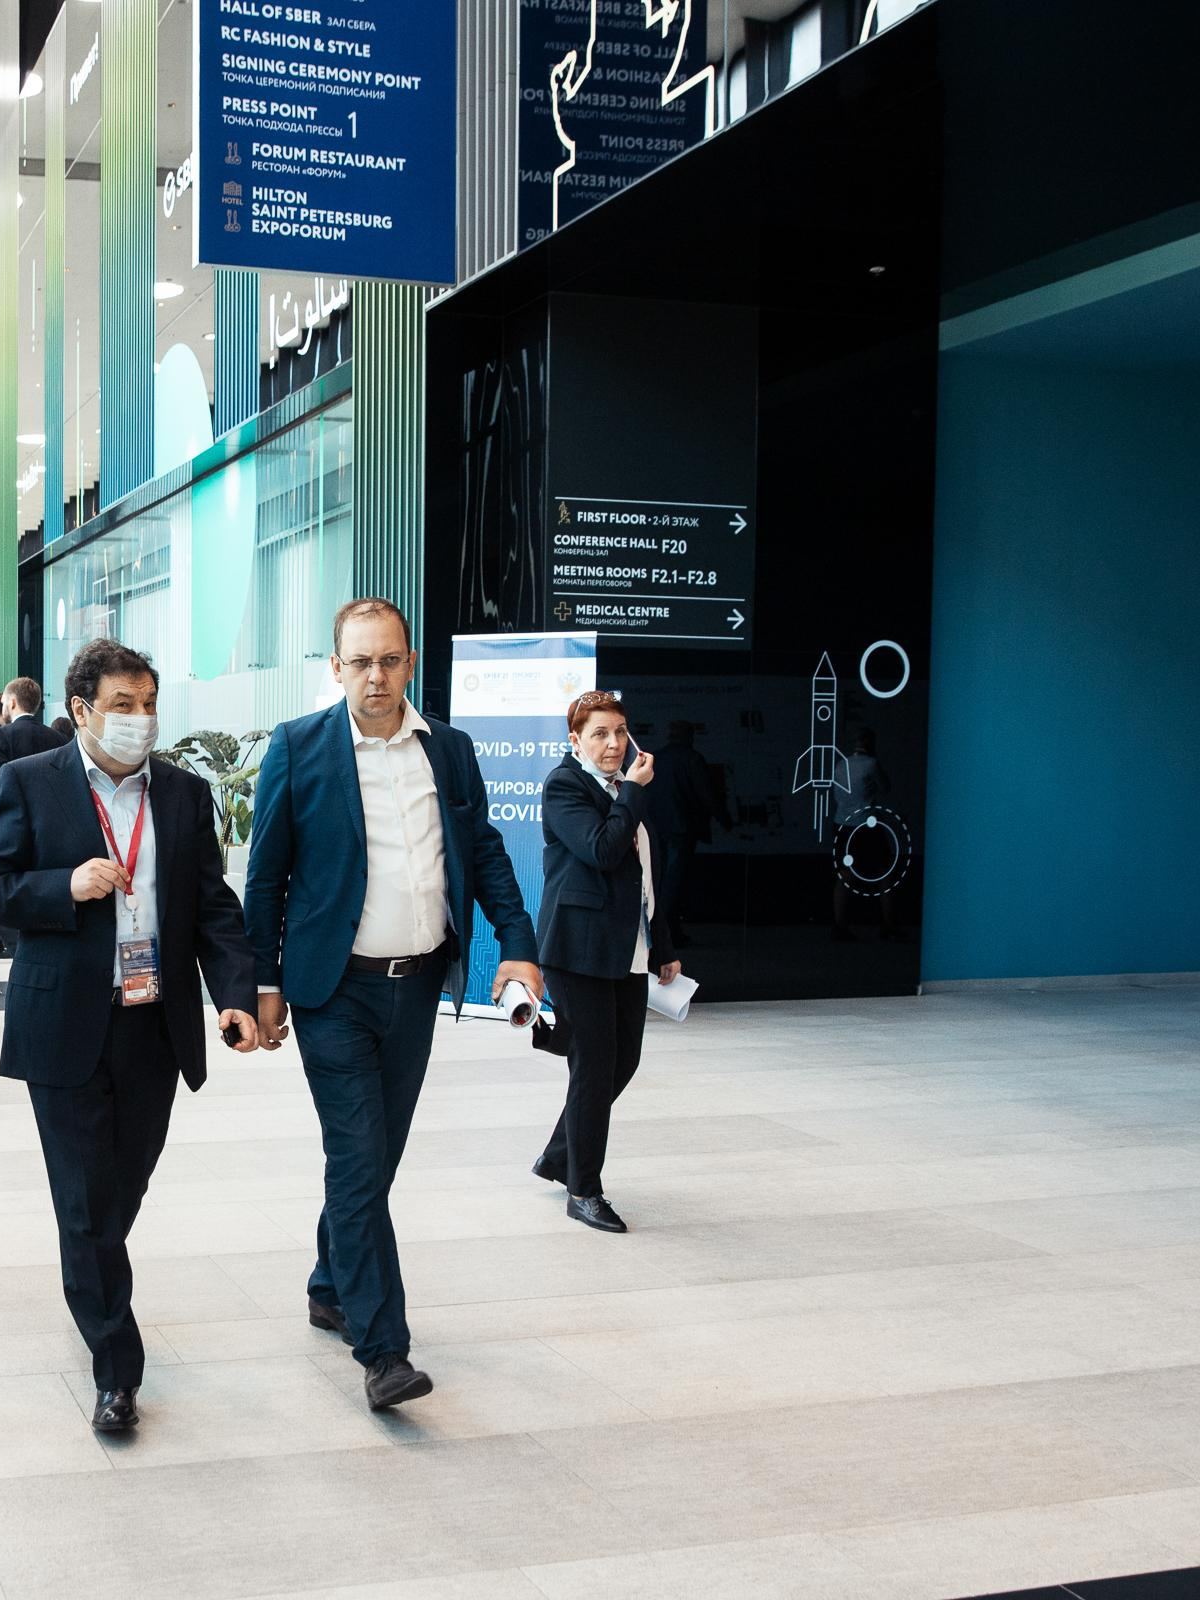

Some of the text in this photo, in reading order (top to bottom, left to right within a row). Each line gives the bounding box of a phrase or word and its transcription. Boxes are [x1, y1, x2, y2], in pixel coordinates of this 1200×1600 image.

[220, 0, 321, 25] HALL OF SBER
[327, 17, 376, 31] ЗАЛ СБЕРА
[221, 25, 370, 58] RC FASHION & STYLE
[222, 54, 421, 90] SIGNING CEREMONY POINT
[222, 72, 386, 100] ТОЧКА ЦЕРЕМОНИЙ ПОДПИСАНИЯ
[223, 96, 317, 120] PRESS POINT
[222, 114, 343, 137] ТОЧКА ПОДХОДА ПРЕССЫ
[347, 111, 357, 138] 1
[252, 142, 406, 171] FORUM RESTAURANT
[252, 160, 347, 179] РЕСТОРАН «ФОРУМ»
[222, 197, 244, 206] HOTEL
[252, 186, 307, 204] HILTON
[252, 203, 392, 229] SAINT PETERSBURG
[252, 220, 346, 241] EXPOFORUM
[577, 511, 646, 525] FIRST FLOOR
[652, 515, 699, 528] 2-Й ЭТАЖ
[553, 534, 687, 555] CONFERENCE HALL F20
[553, 547, 608, 557] КОНФЕРЕНЦ-ЗАЛ
[553, 565, 604, 578] MEETING
[606, 567, 647, 579] ROOMS
[553, 578, 632, 588] КОМНАТЫ ПЕРЕГОВОРОВ
[576, 604, 670, 618] MEDICAL CENTRE
[575, 617, 649, 628] МЕДИЦИНСКИЙ ЦЕНТР
[473, 741, 536, 757] OVID-19
